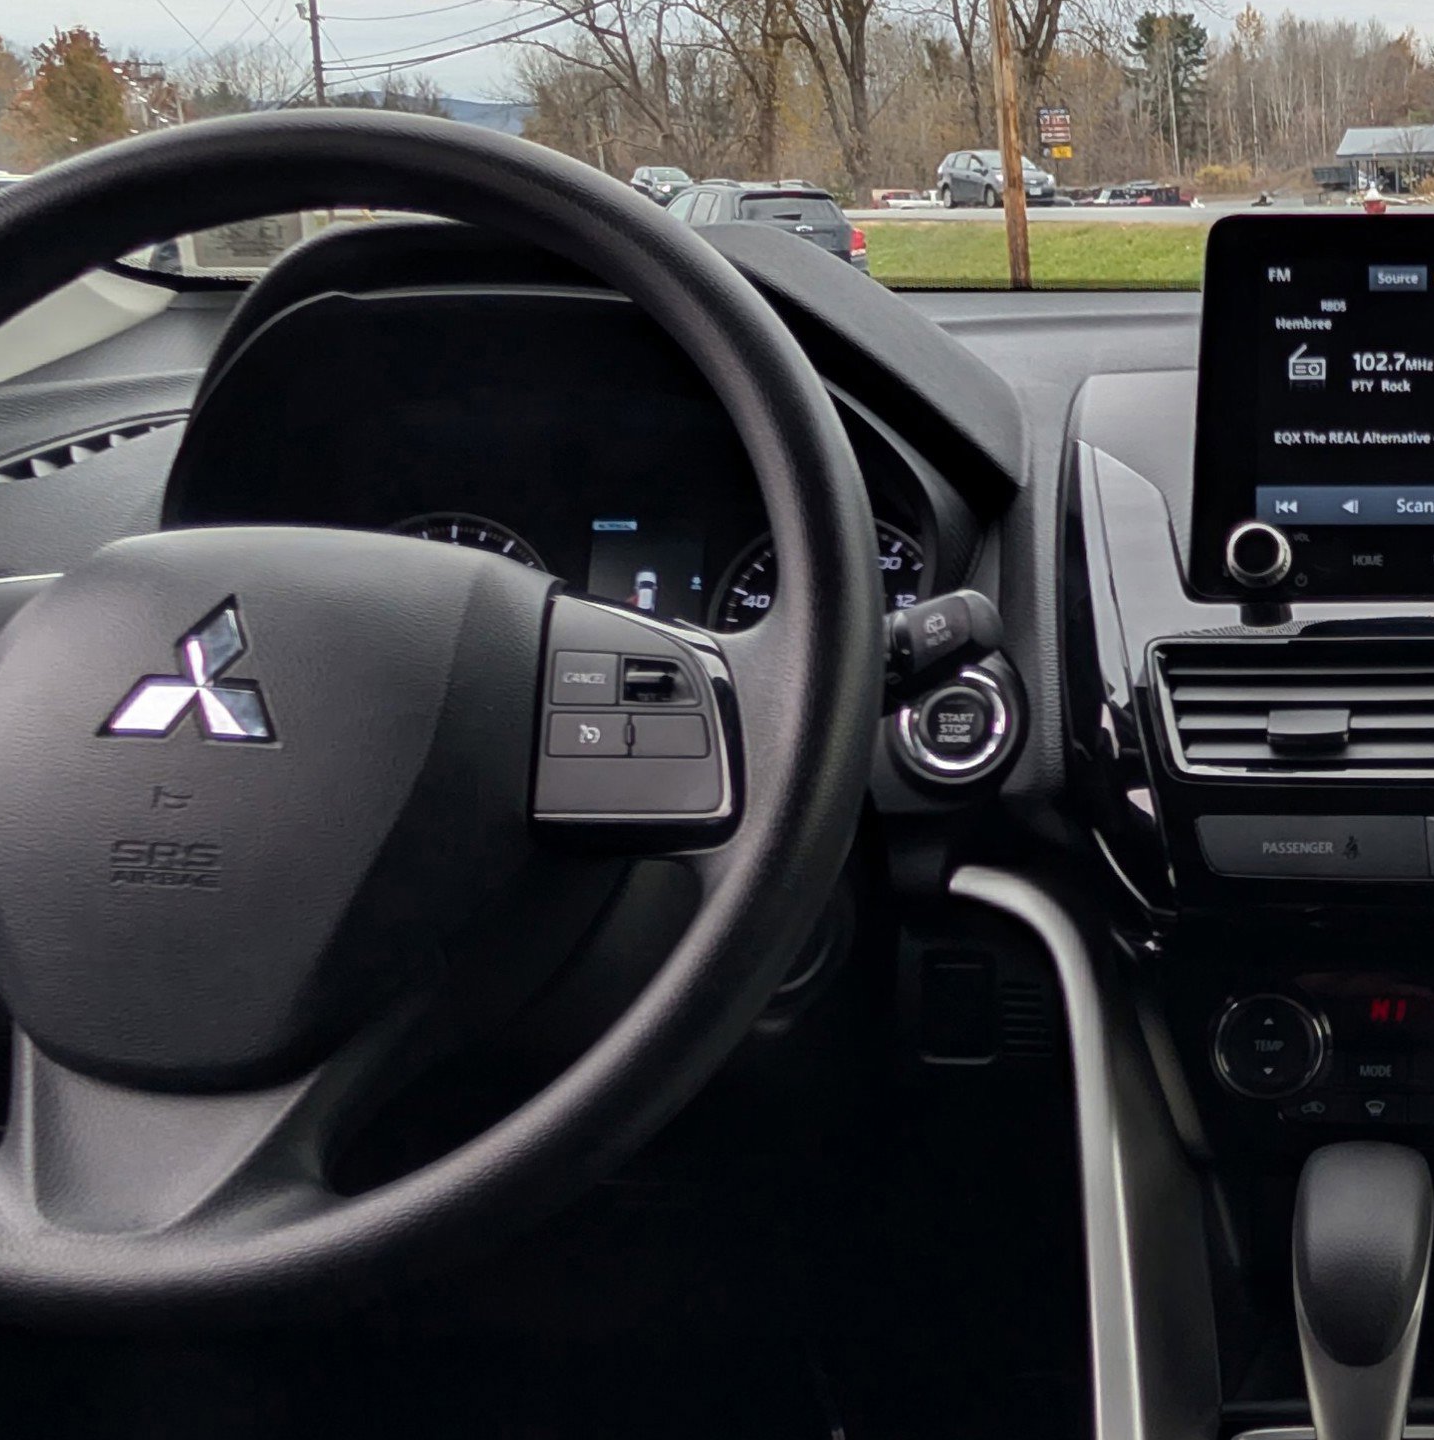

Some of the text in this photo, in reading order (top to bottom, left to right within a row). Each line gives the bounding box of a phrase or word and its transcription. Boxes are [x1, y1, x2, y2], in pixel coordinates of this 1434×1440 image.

[1268, 267, 1291, 282] FM
[1377, 272, 1419, 285] Source
[1275, 317, 1332, 330] Hembree
[1351, 379, 1411, 393] PTY Rock
[1273, 431, 1301, 446] EQX
[1304, 431, 1326, 444] The
[1329, 431, 1360, 445] REAL
[1362, 430, 1431, 445] Alternative
[1396, 498, 1434, 514] Scan
[1352, 554, 1384, 567] HOME
[742, 594, 770, 609] 40
[563, 672, 607, 685] CANCEL
[938, 713, 974, 724] START
[940, 724, 970, 735] STOP
[938, 734, 971, 744] ENGINE
[110, 839, 224, 868] SRS
[1262, 841, 1334, 855] PASSENGER
[1254, 1041, 1285, 1053] TEMP
[1359, 1065, 1393, 1078] MODE
